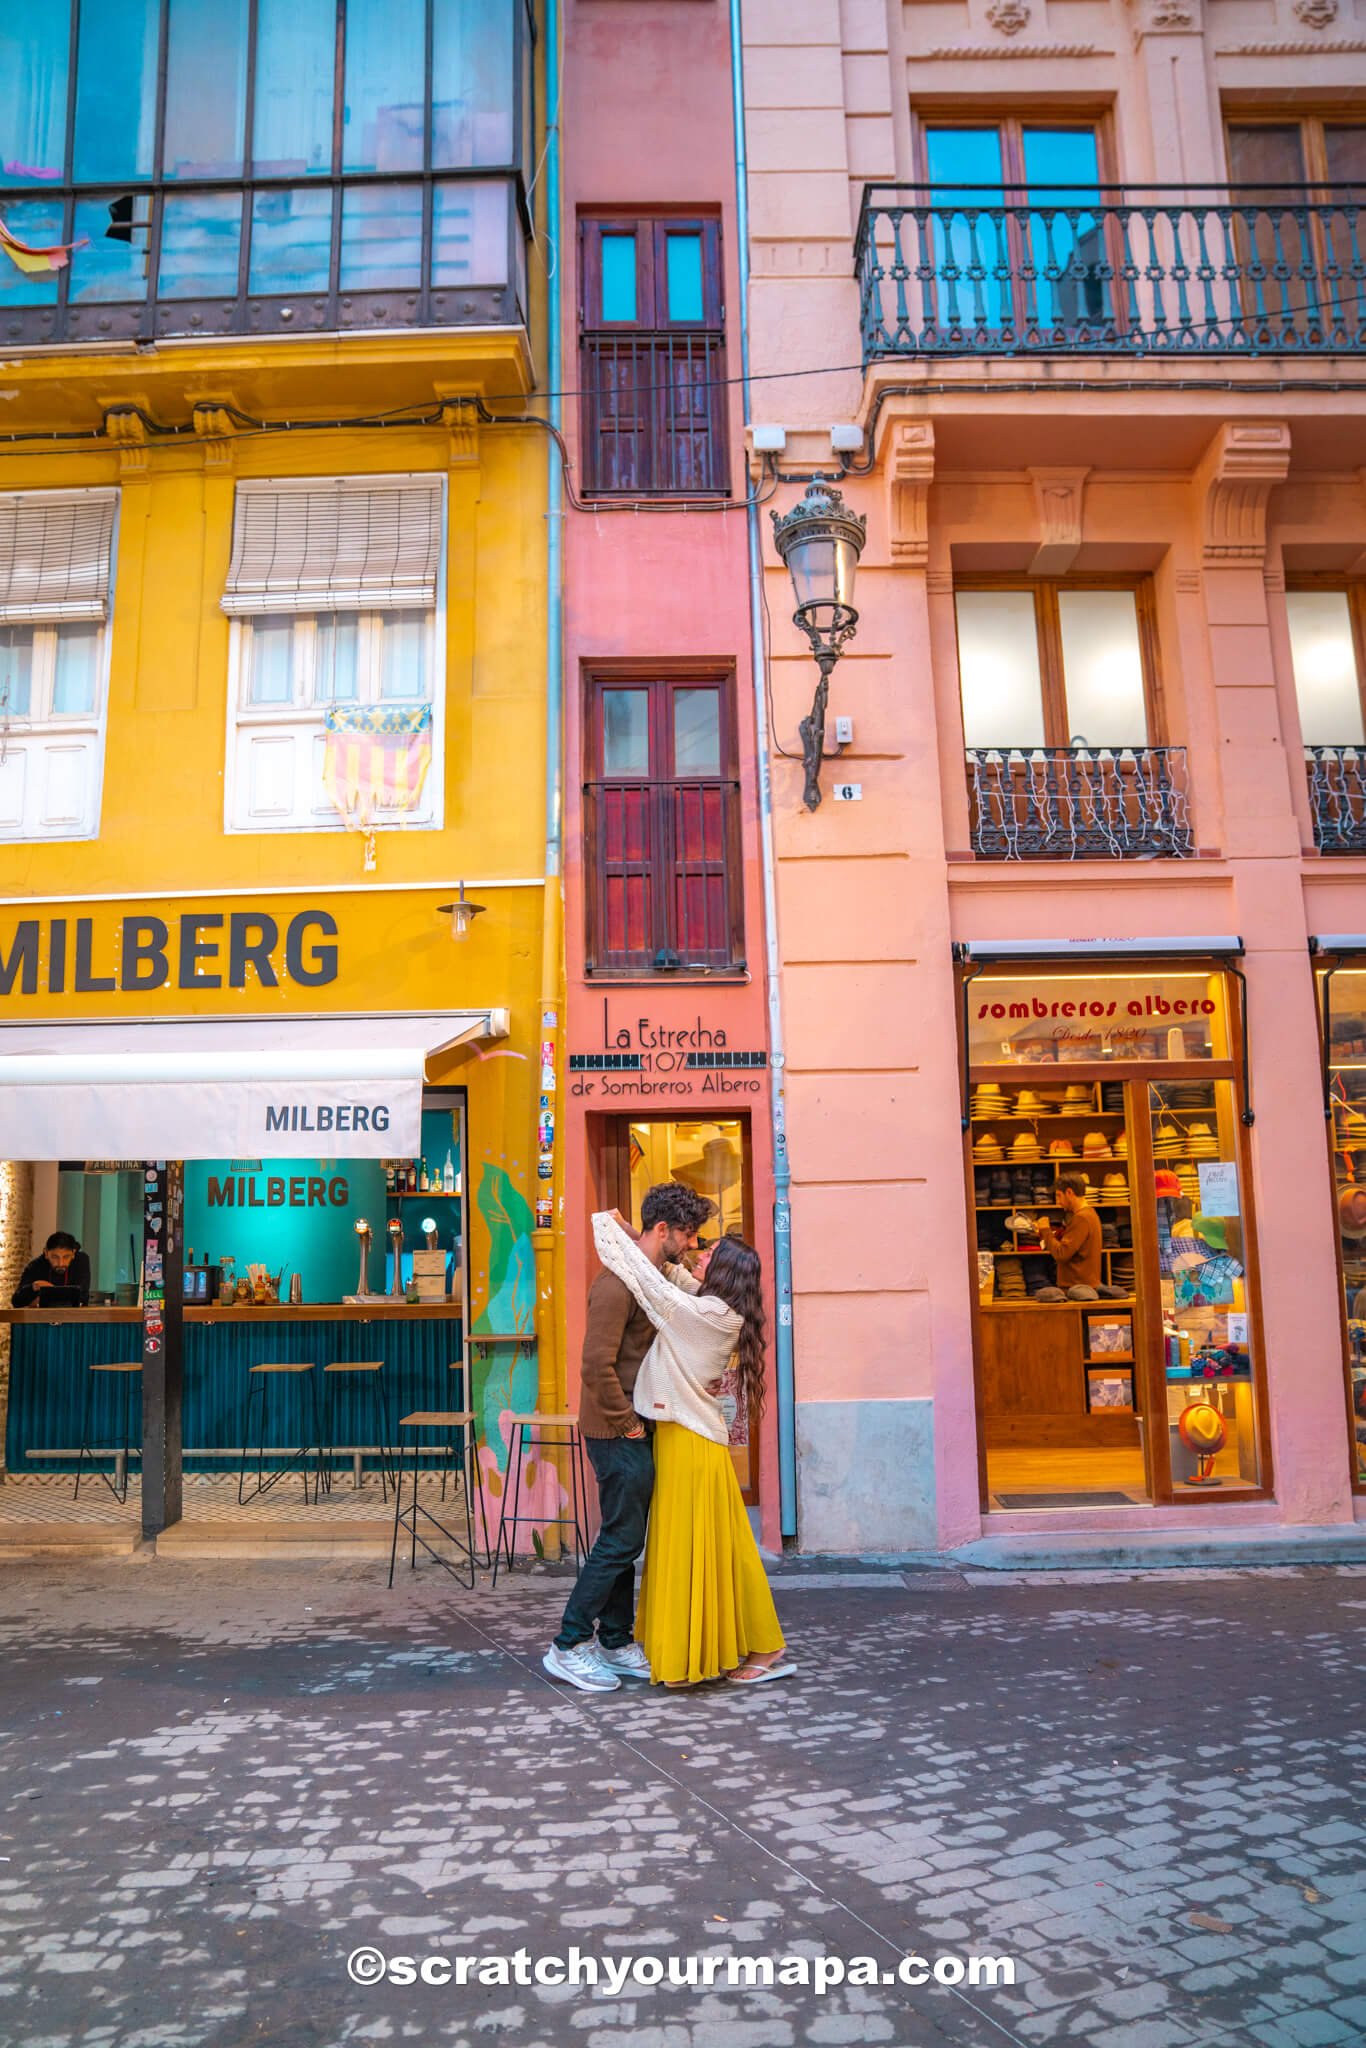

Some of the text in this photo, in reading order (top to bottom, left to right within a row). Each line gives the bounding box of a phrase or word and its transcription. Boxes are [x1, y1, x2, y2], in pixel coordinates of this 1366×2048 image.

[842, 786, 853, 800] 6
[0, 910, 338, 995] MILBERG
[978, 995, 1216, 1019] sombreros albero
[604, 997, 727, 1049] La Estrecha
[1104, 1025, 1148, 1041] 1820
[571, 1074, 595, 1096] de
[601, 1074, 693, 1095] Sombreros
[701, 1072, 761, 1094] Albero
[265, 1105, 390, 1131] MILBERG
[207, 1176, 349, 1207] MILBERG
